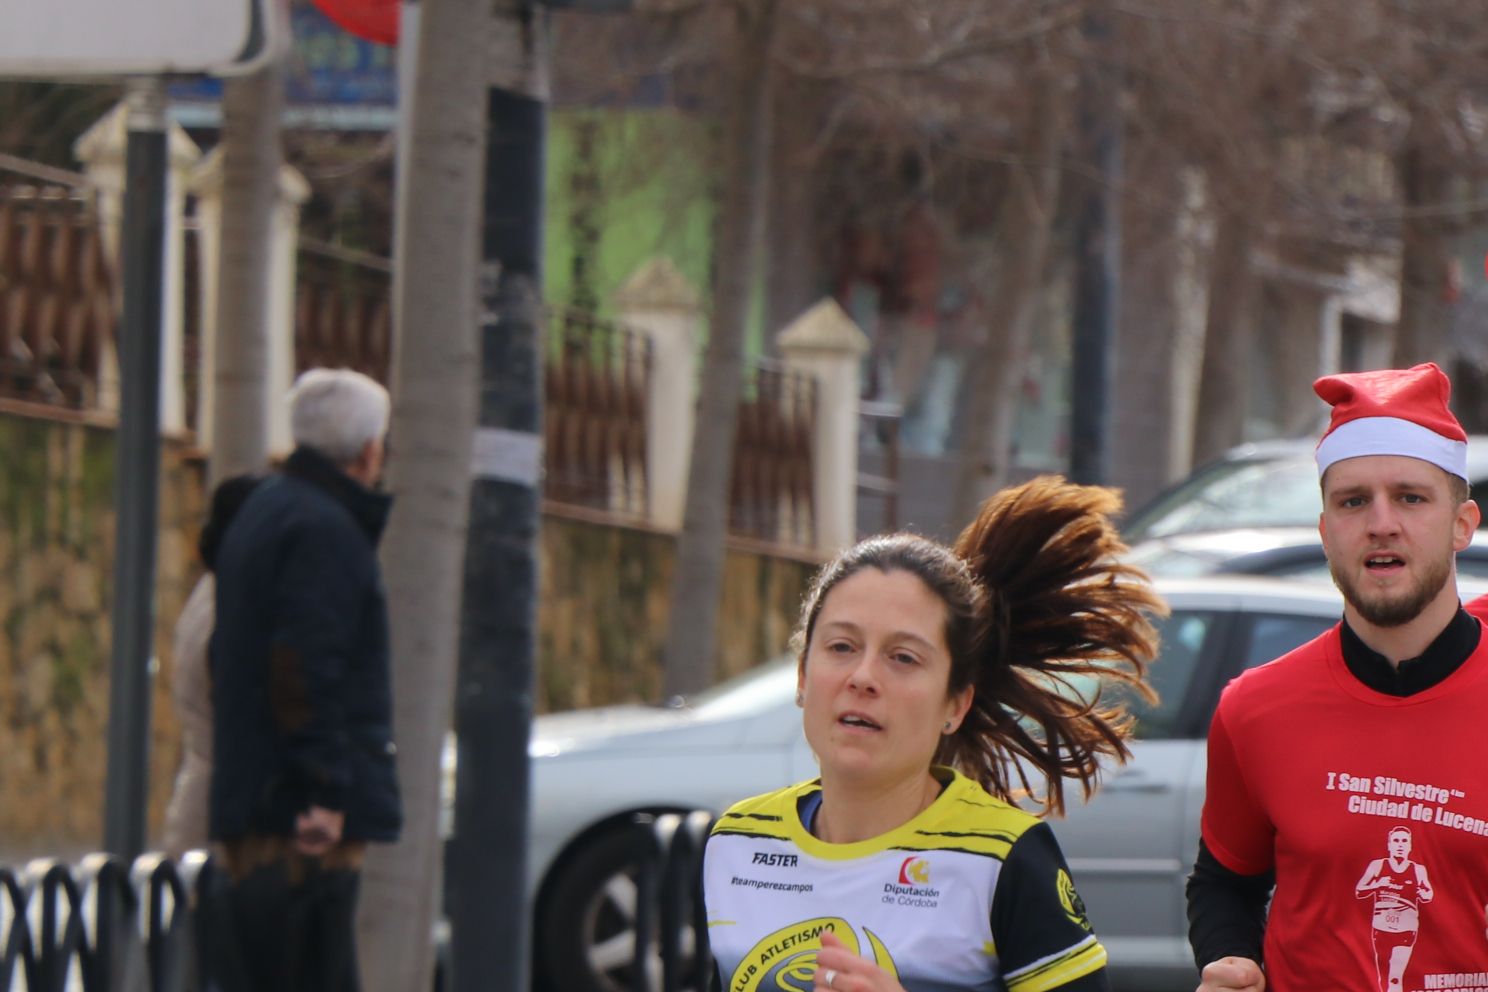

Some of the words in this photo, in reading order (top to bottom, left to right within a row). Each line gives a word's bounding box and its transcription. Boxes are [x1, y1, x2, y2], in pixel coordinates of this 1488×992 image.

[1326, 772, 1336, 790] I
[1338, 773, 1371, 793] San
[1373, 776, 1450, 804] Silvestre
[1348, 795, 1409, 819] Ciudad
[1410, 803, 1433, 822] de
[752, 852, 798, 867] FASTER
[731, 876, 814, 894] #teamperezcampos
[884, 883, 940, 898] Diputación
[882, 895, 894, 904] de
[897, 895, 938, 909] Córdoba
